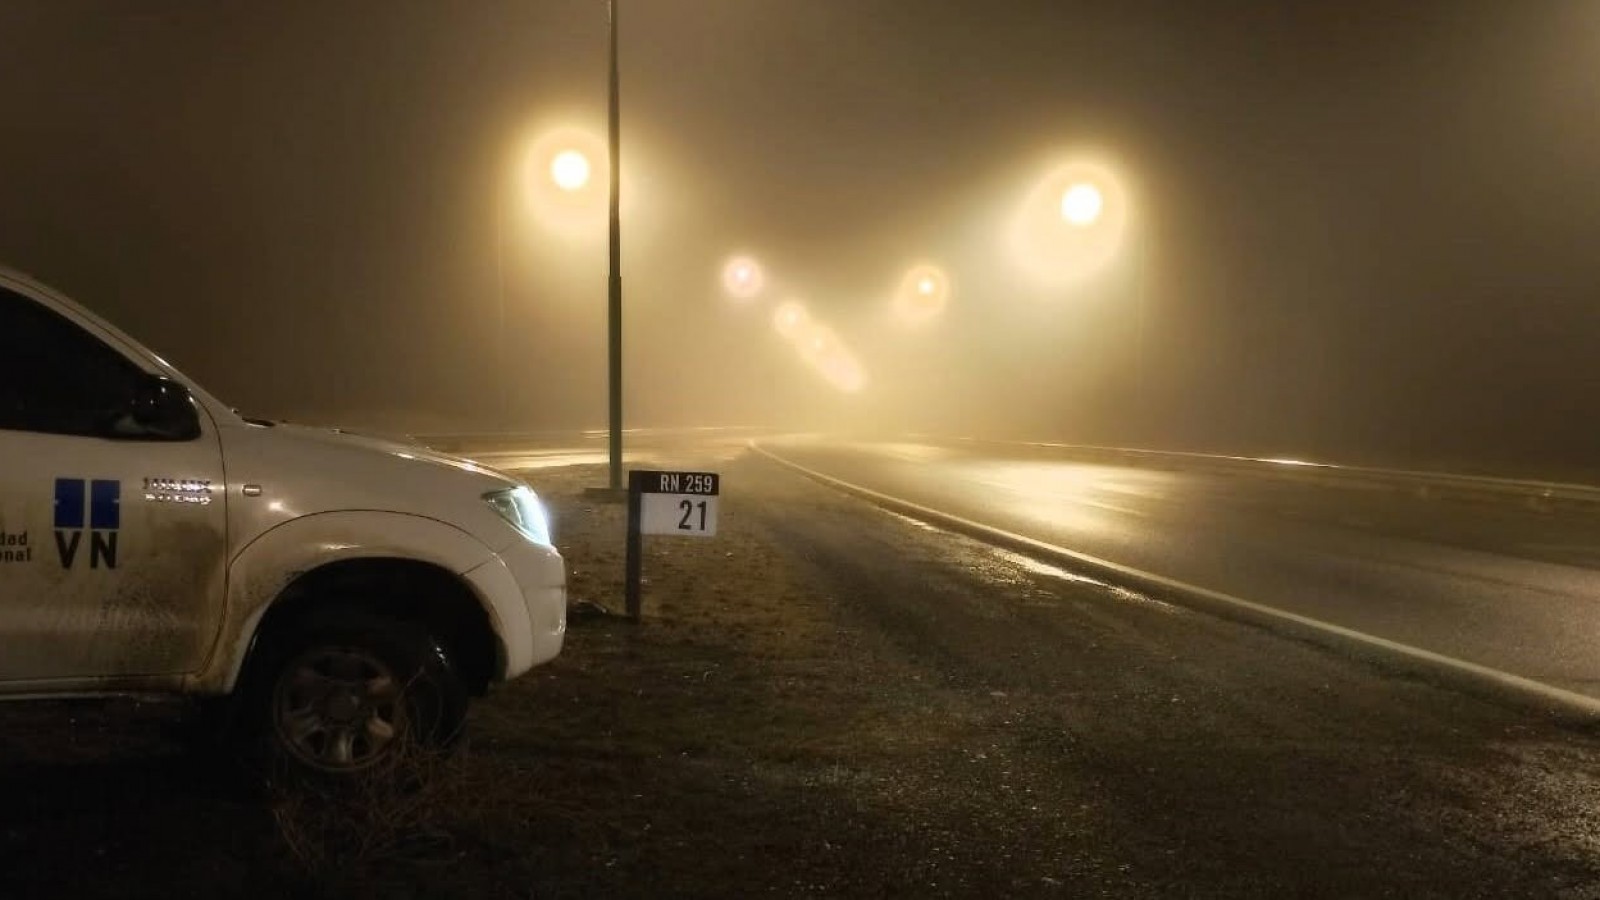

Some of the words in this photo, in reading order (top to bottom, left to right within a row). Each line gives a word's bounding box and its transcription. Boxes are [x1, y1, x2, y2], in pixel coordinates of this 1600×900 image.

[660, 474, 680, 492] RN
[685, 475, 713, 492] 259
[678, 500, 707, 530] 21
